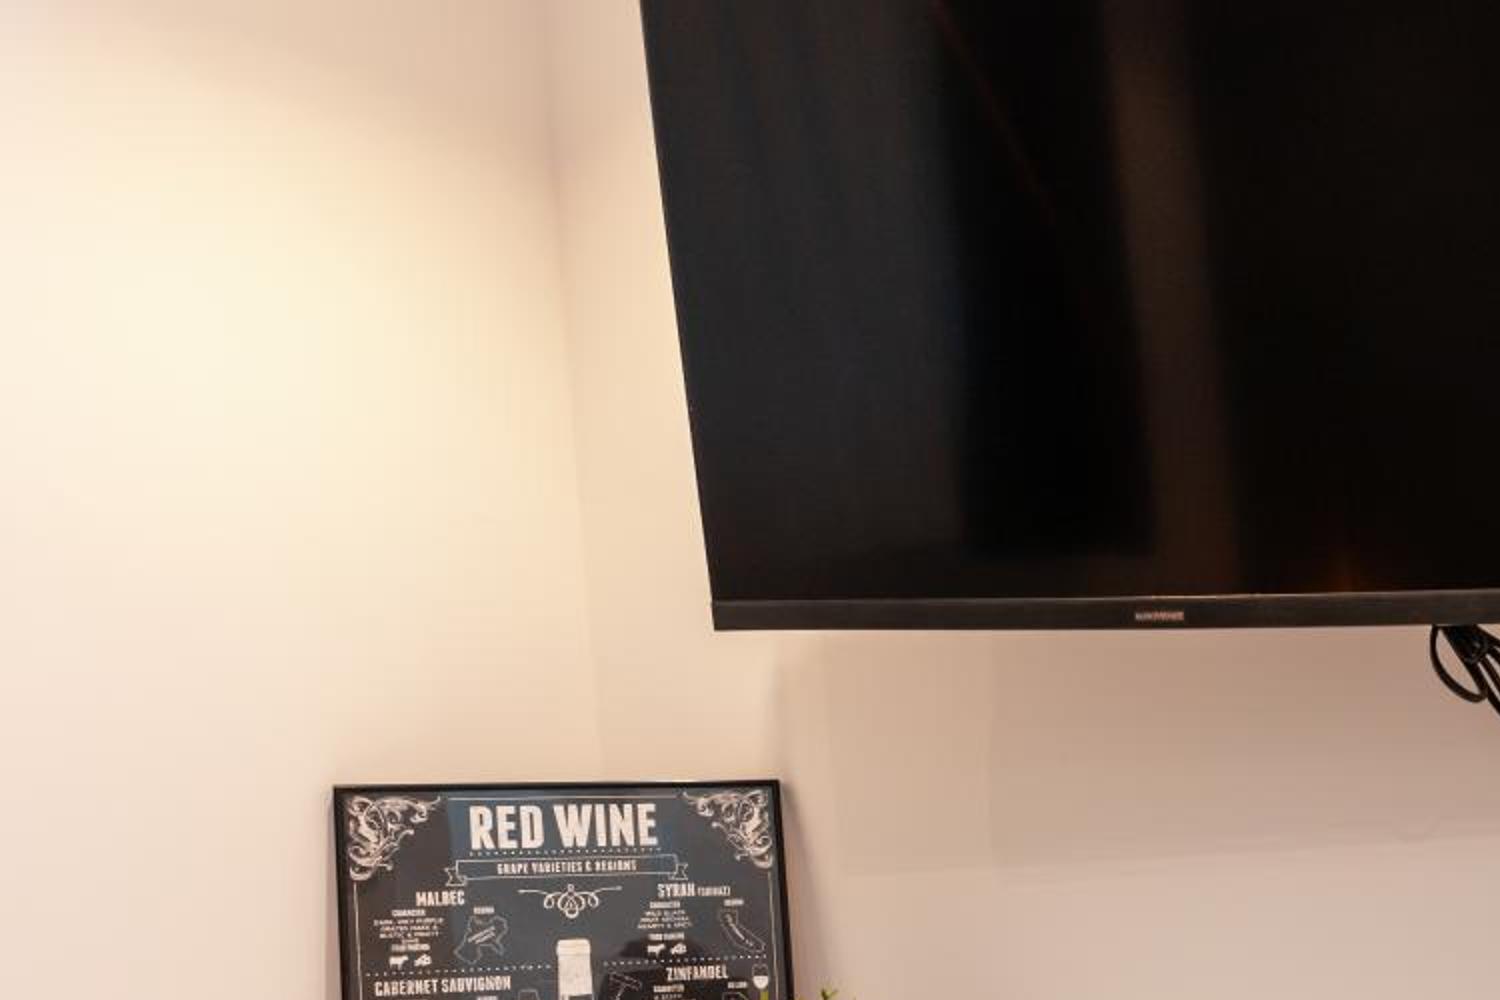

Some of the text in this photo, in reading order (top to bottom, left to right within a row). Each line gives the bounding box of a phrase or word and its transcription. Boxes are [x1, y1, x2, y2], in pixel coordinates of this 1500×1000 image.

[469, 803, 658, 850] RED WINE
[497, 861, 529, 875] GRAPE
[531, 861, 583, 874] VARIETIES
[595, 859, 637, 872] REGIONS
[415, 890, 466, 907] MALBEC
[657, 883, 696, 898] SYRAH
[665, 964, 729, 981] ZINFANDEL
[374, 975, 512, 997] CABERNET SAUVIGNON
